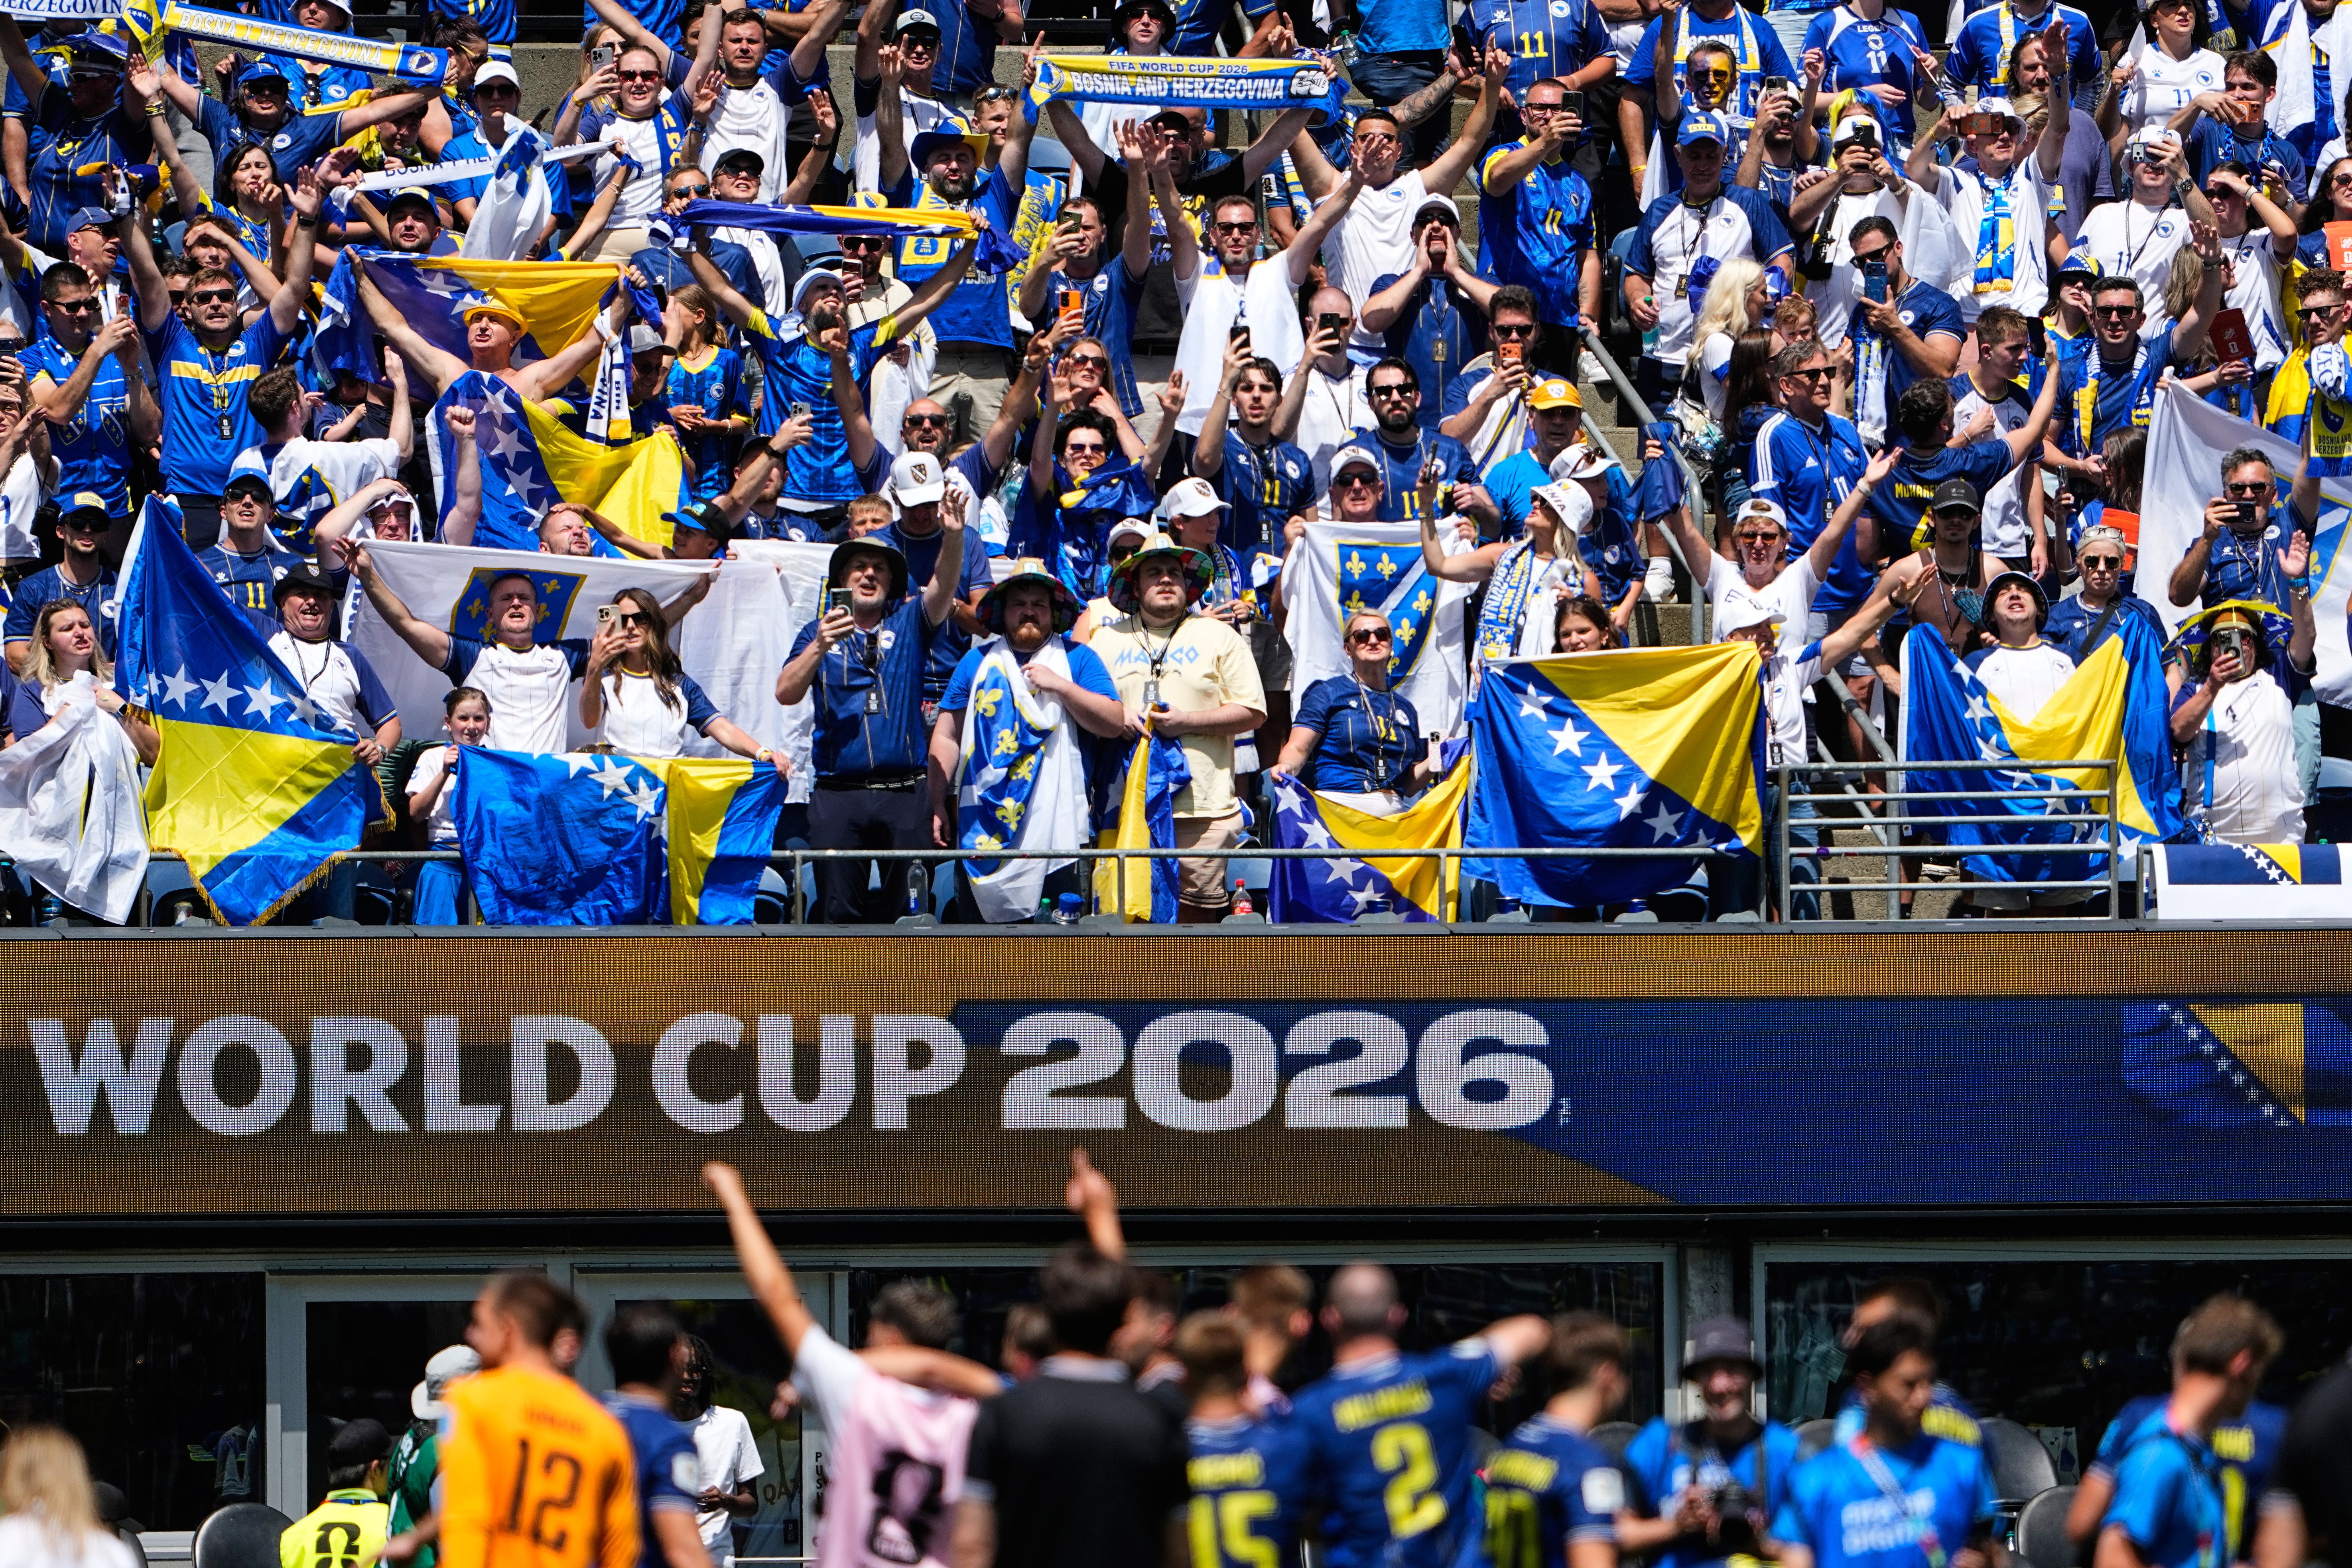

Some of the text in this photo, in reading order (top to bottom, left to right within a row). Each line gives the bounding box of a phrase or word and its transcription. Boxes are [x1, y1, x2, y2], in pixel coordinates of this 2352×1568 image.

[179, 11, 235, 39] BOSNA
[241, 24, 250, 42] I
[256, 26, 382, 65] HERCEGOVINA
[1520, 31, 1548, 58] 11
[1109, 61, 1249, 75] FIFA WORLD CUP 2026
[1866, 51, 1891, 73] 11
[1070, 70, 1133, 96] BOSNIA
[1134, 75, 1169, 97] AND
[1172, 77, 1284, 100] HERZEGOVINA
[2173, 89, 2192, 106] 11
[1545, 208, 1562, 235] 11
[2318, 433, 2352, 444] BOSNIA AND
[1264, 479, 1280, 505] 11
[1401, 491, 1419, 519] 11
[246, 582, 266, 609] 11
[1498, 588, 1517, 623] MOJU
[1377, 715, 1398, 741] 11
[27, 1009, 1555, 1137] WORLD CUP 2026
[1370, 1422, 1449, 1538] 2
[504, 1438, 584, 1550] 12
[1186, 1489, 1280, 1568] 15
